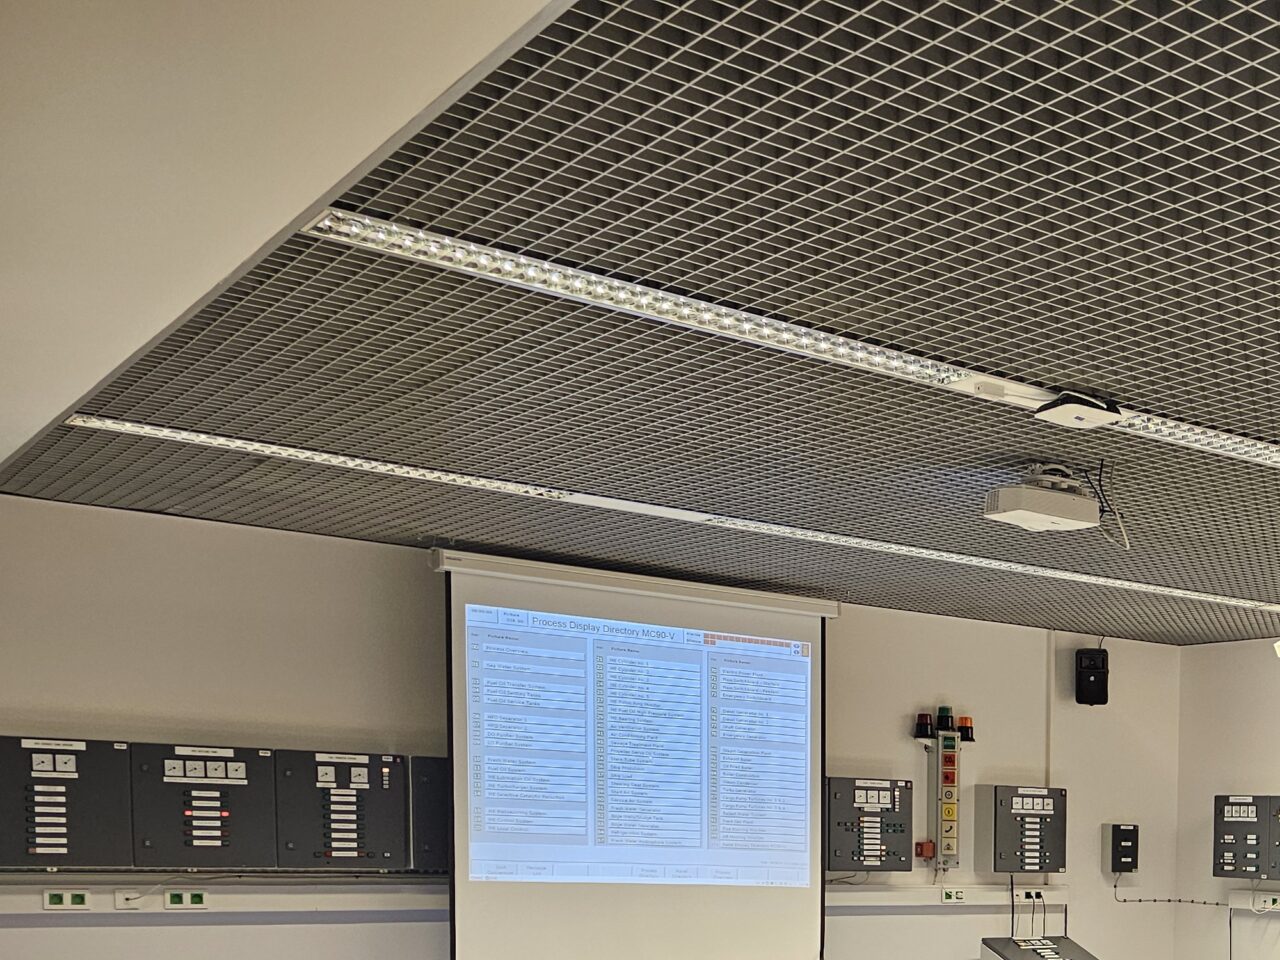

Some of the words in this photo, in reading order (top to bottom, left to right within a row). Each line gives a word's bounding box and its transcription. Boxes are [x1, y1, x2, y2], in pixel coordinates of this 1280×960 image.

[532, 616, 568, 629] Process
[570, 620, 601, 633] Display
[603, 624, 640, 639] Directory
[642, 629, 676, 641] MC90-V
